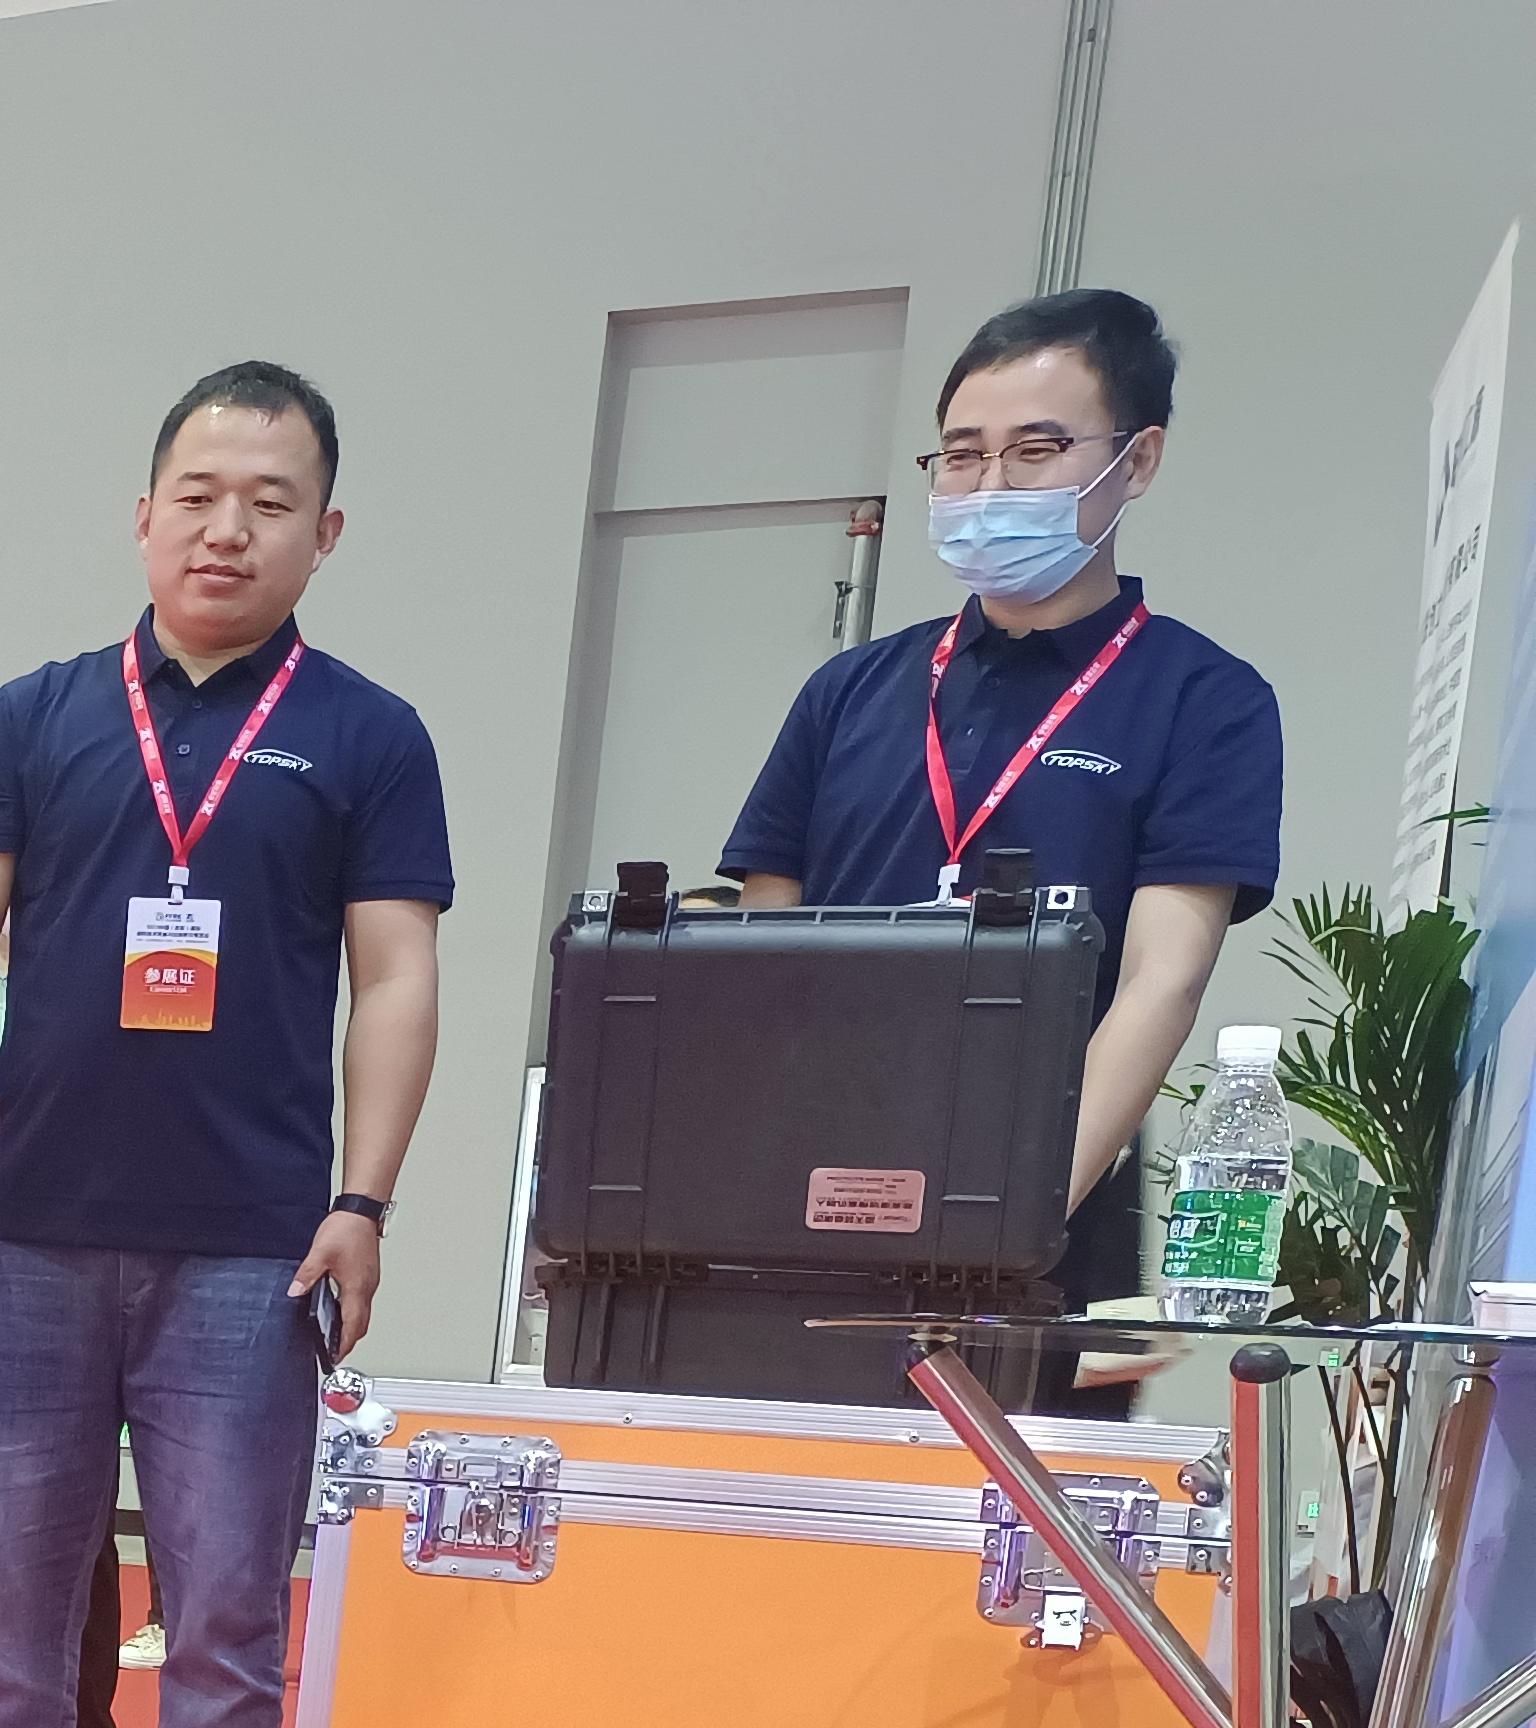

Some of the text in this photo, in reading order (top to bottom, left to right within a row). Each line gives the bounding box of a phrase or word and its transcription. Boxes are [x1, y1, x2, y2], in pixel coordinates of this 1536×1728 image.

[249, 753, 313, 772] TOPSKY
[1047, 754, 1121, 775] TOPSKY
[144, 967, 196, 985] 参展证
